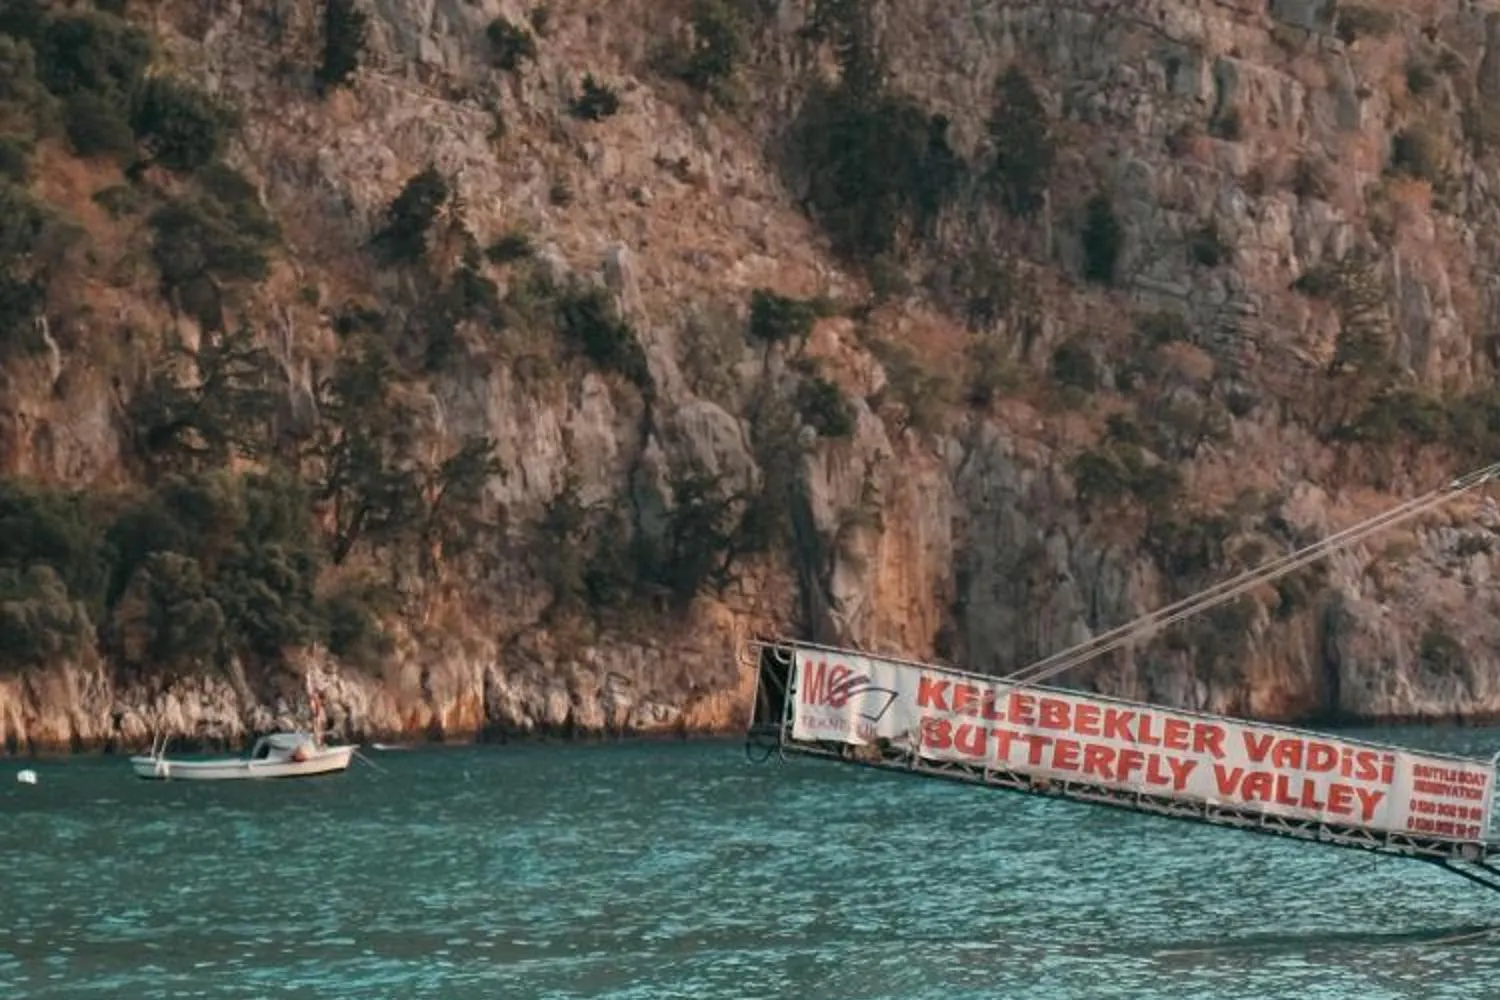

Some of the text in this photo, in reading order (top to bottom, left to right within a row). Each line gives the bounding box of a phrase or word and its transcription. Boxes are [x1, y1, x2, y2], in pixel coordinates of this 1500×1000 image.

[916, 676, 1226, 759] KELEBEKLER
[919, 715, 1386, 822] BUTTERFLY VALLEY
